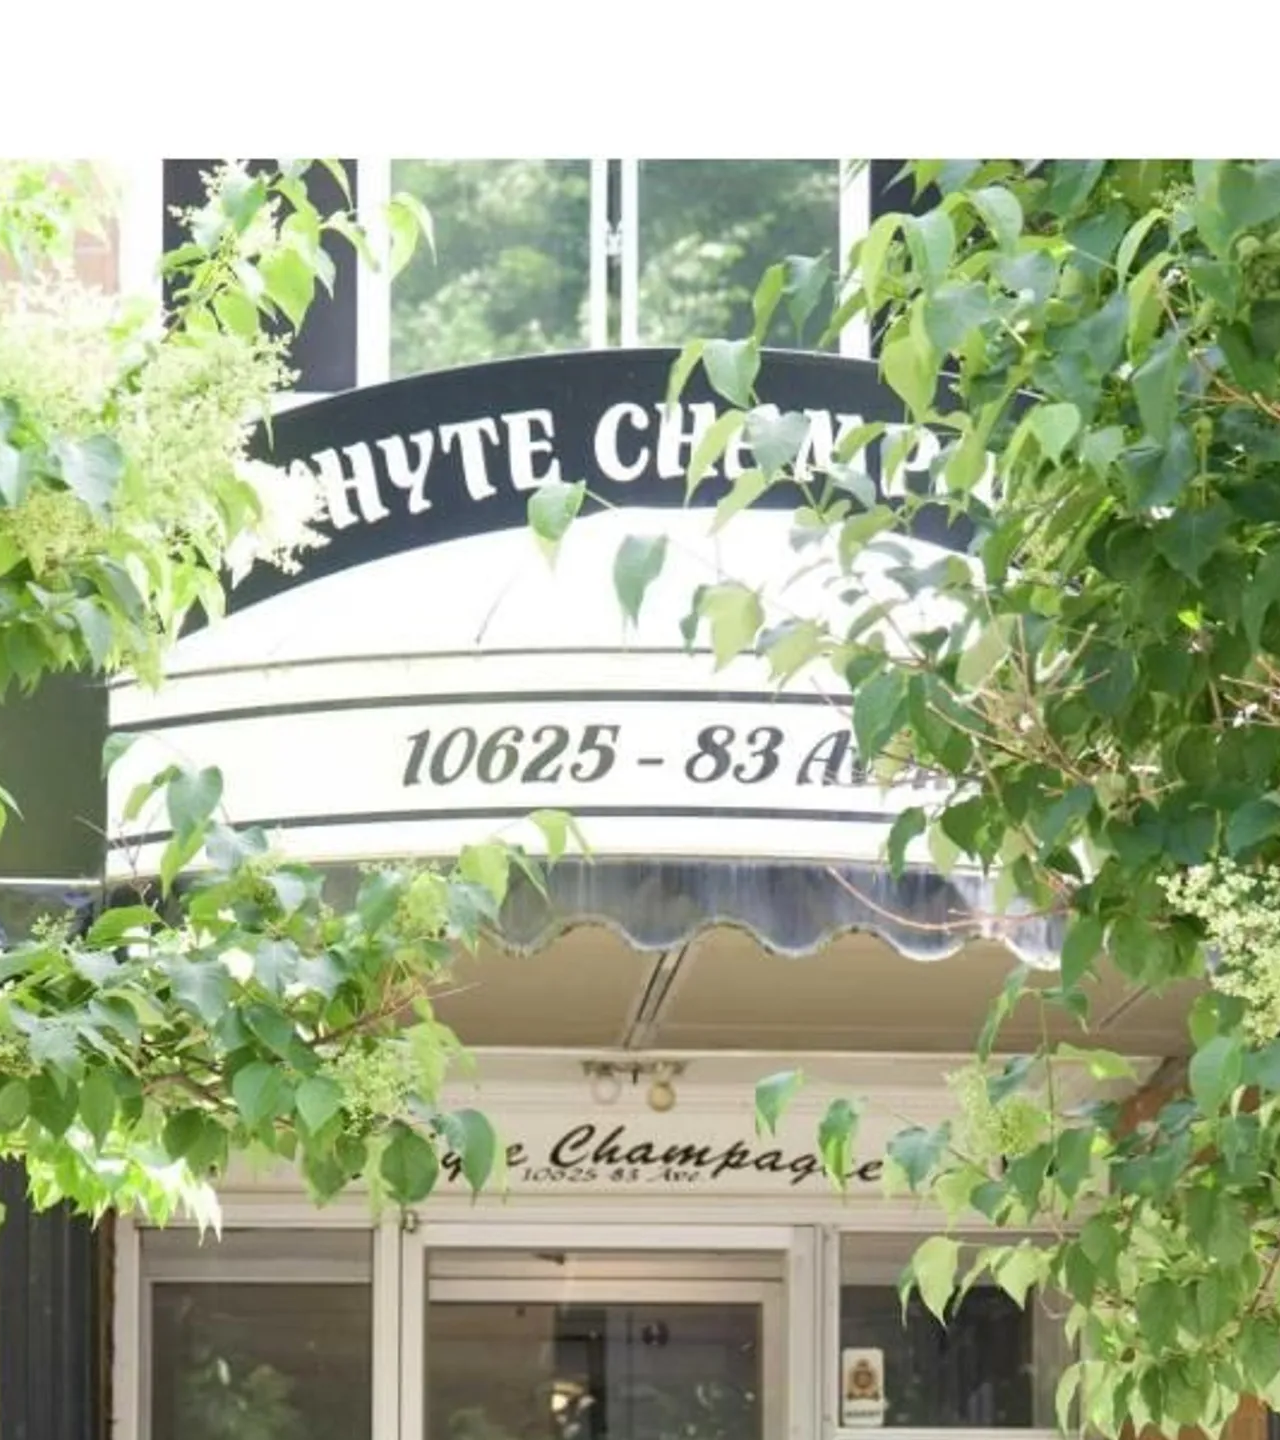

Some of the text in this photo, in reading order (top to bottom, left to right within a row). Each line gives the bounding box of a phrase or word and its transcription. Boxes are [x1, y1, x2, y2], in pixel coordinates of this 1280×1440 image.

[292, 408, 561, 530] HYTE
[403, 725, 621, 786] 10625
[685, 725, 784, 784] 83
[549, 1123, 884, 1186] Champage
